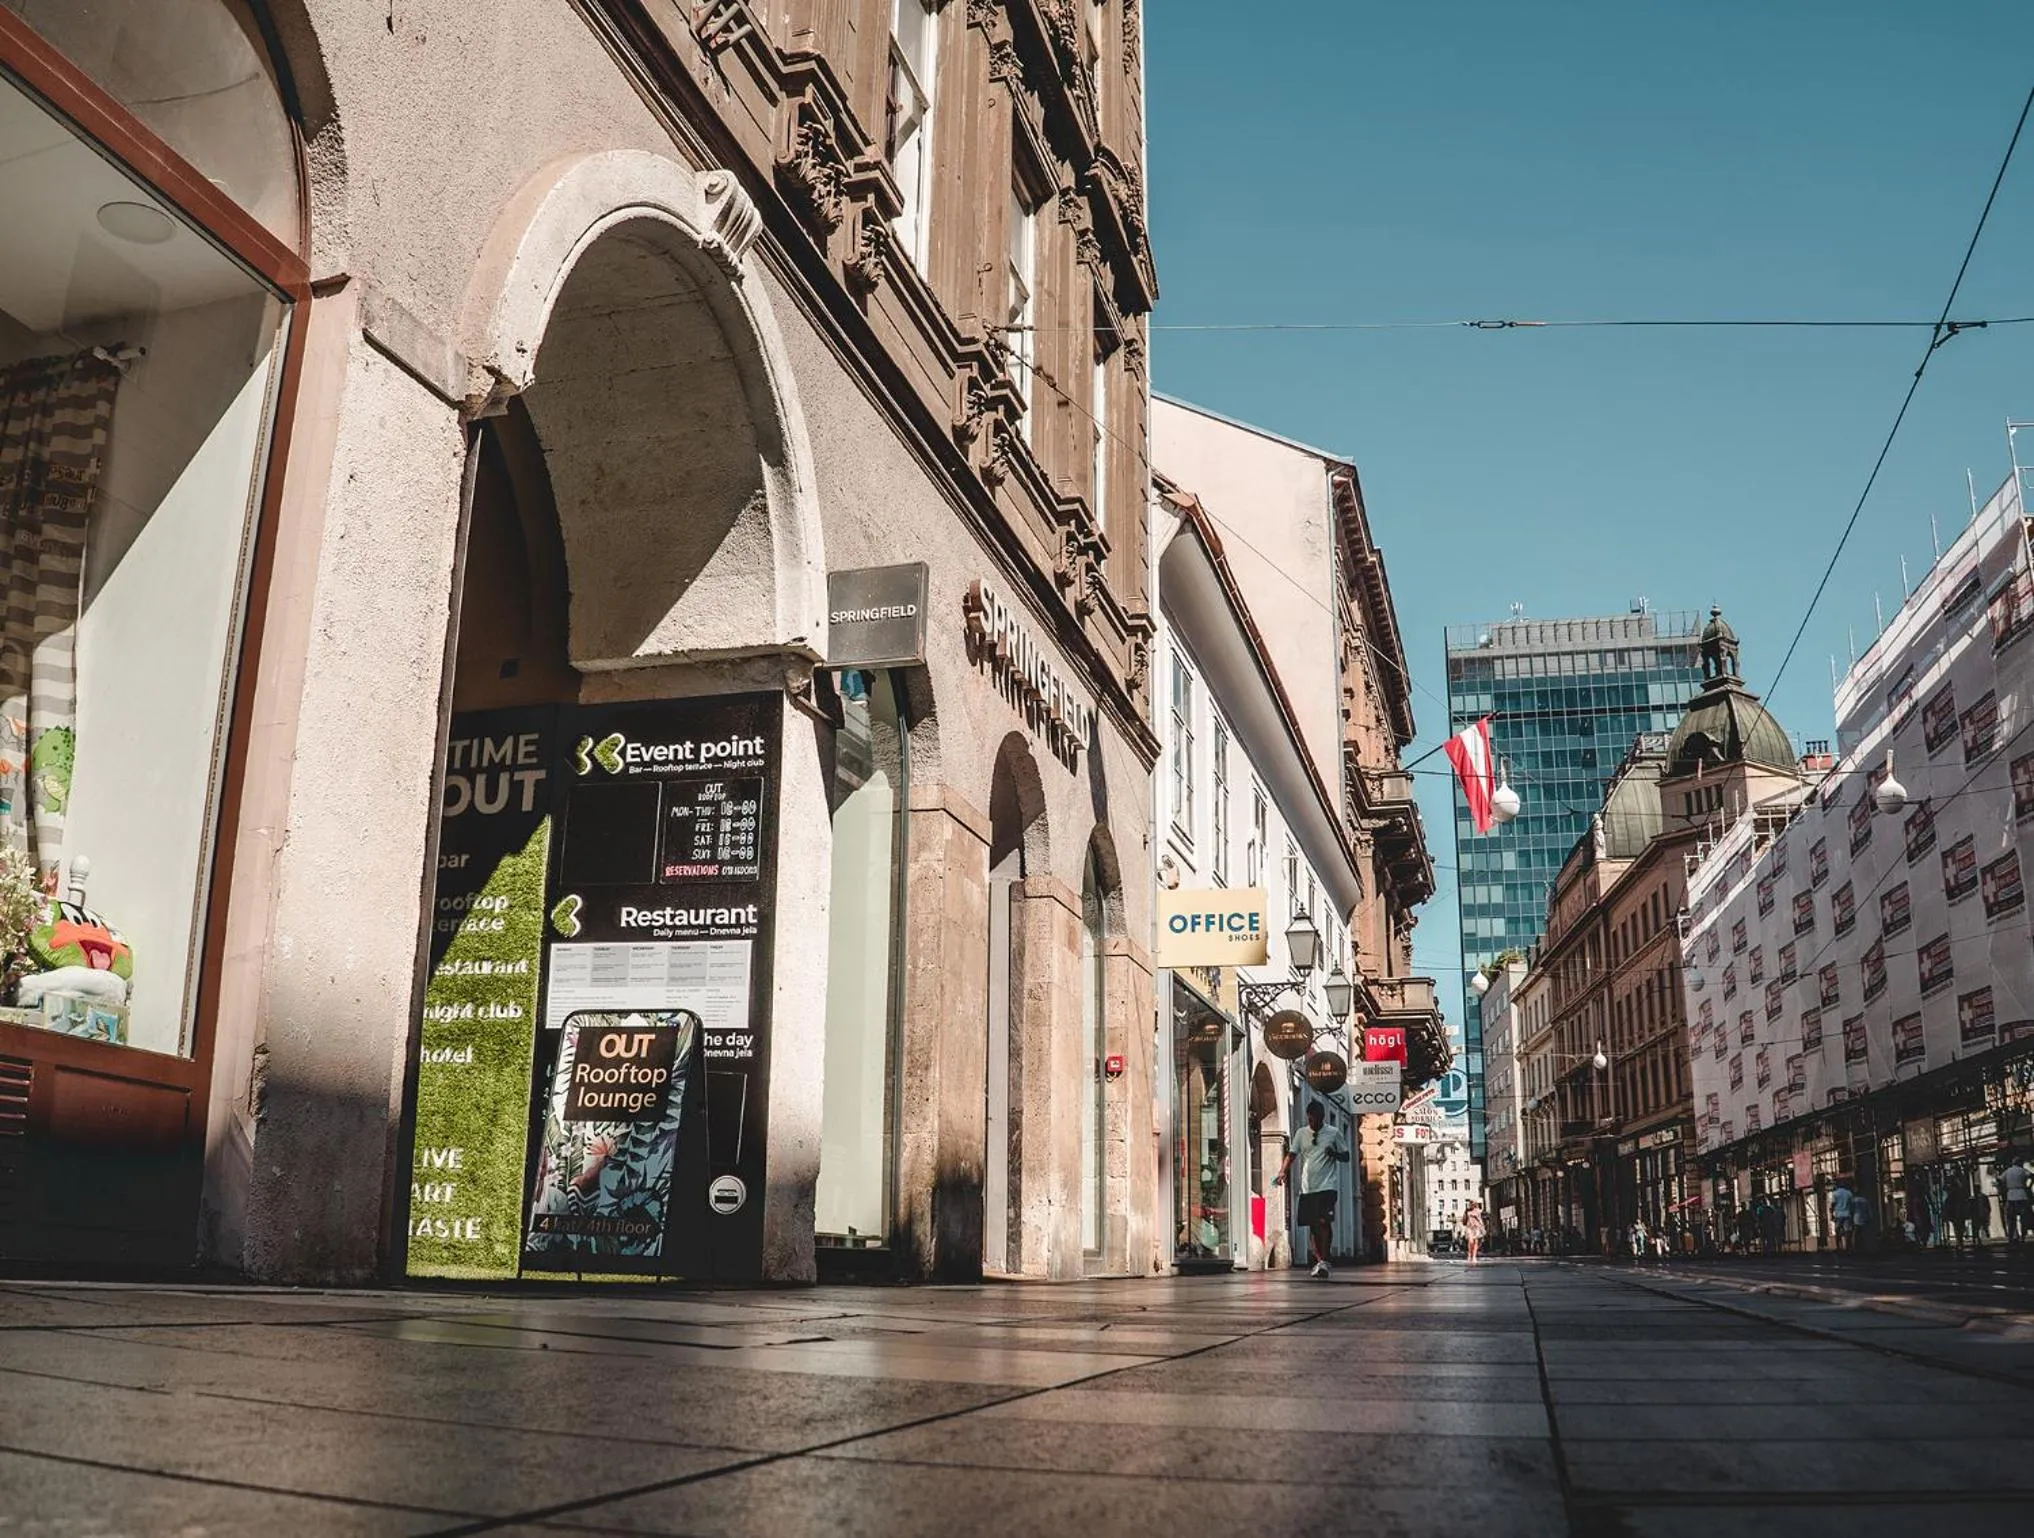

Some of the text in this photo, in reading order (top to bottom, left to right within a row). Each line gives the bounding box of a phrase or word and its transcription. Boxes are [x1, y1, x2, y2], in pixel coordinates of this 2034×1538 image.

[830, 604, 917, 625] SPRINGFIELD
[978, 578, 1091, 750] SPRINGFIELD
[449, 733, 539, 769] TIME
[626, 735, 765, 763] Event point
[628, 765, 643, 774] Bar
[652, 763, 684, 775] Rooftop
[723, 760, 746, 770] Night
[441, 770, 547, 817] OUT
[704, 783, 723, 793] OUT
[438, 893, 509, 912] ooftop
[435, 918, 505, 932] errace
[620, 904, 758, 928] Restaurant
[1168, 912, 1260, 934] OFFICE
[653, 928, 673, 938] Daily
[710, 926, 741, 936] Dnevna
[1228, 934, 1260, 942] SHOES
[434, 960, 529, 976] estaurant
[424, 1001, 523, 1023] night club
[600, 1033, 656, 1058] OUT
[703, 1032, 753, 1048] he day
[420, 1045, 473, 1063] hotel
[575, 1062, 668, 1088] Rooftop
[577, 1086, 657, 1113] lounge
[1353, 1092, 1397, 1105] ecco
